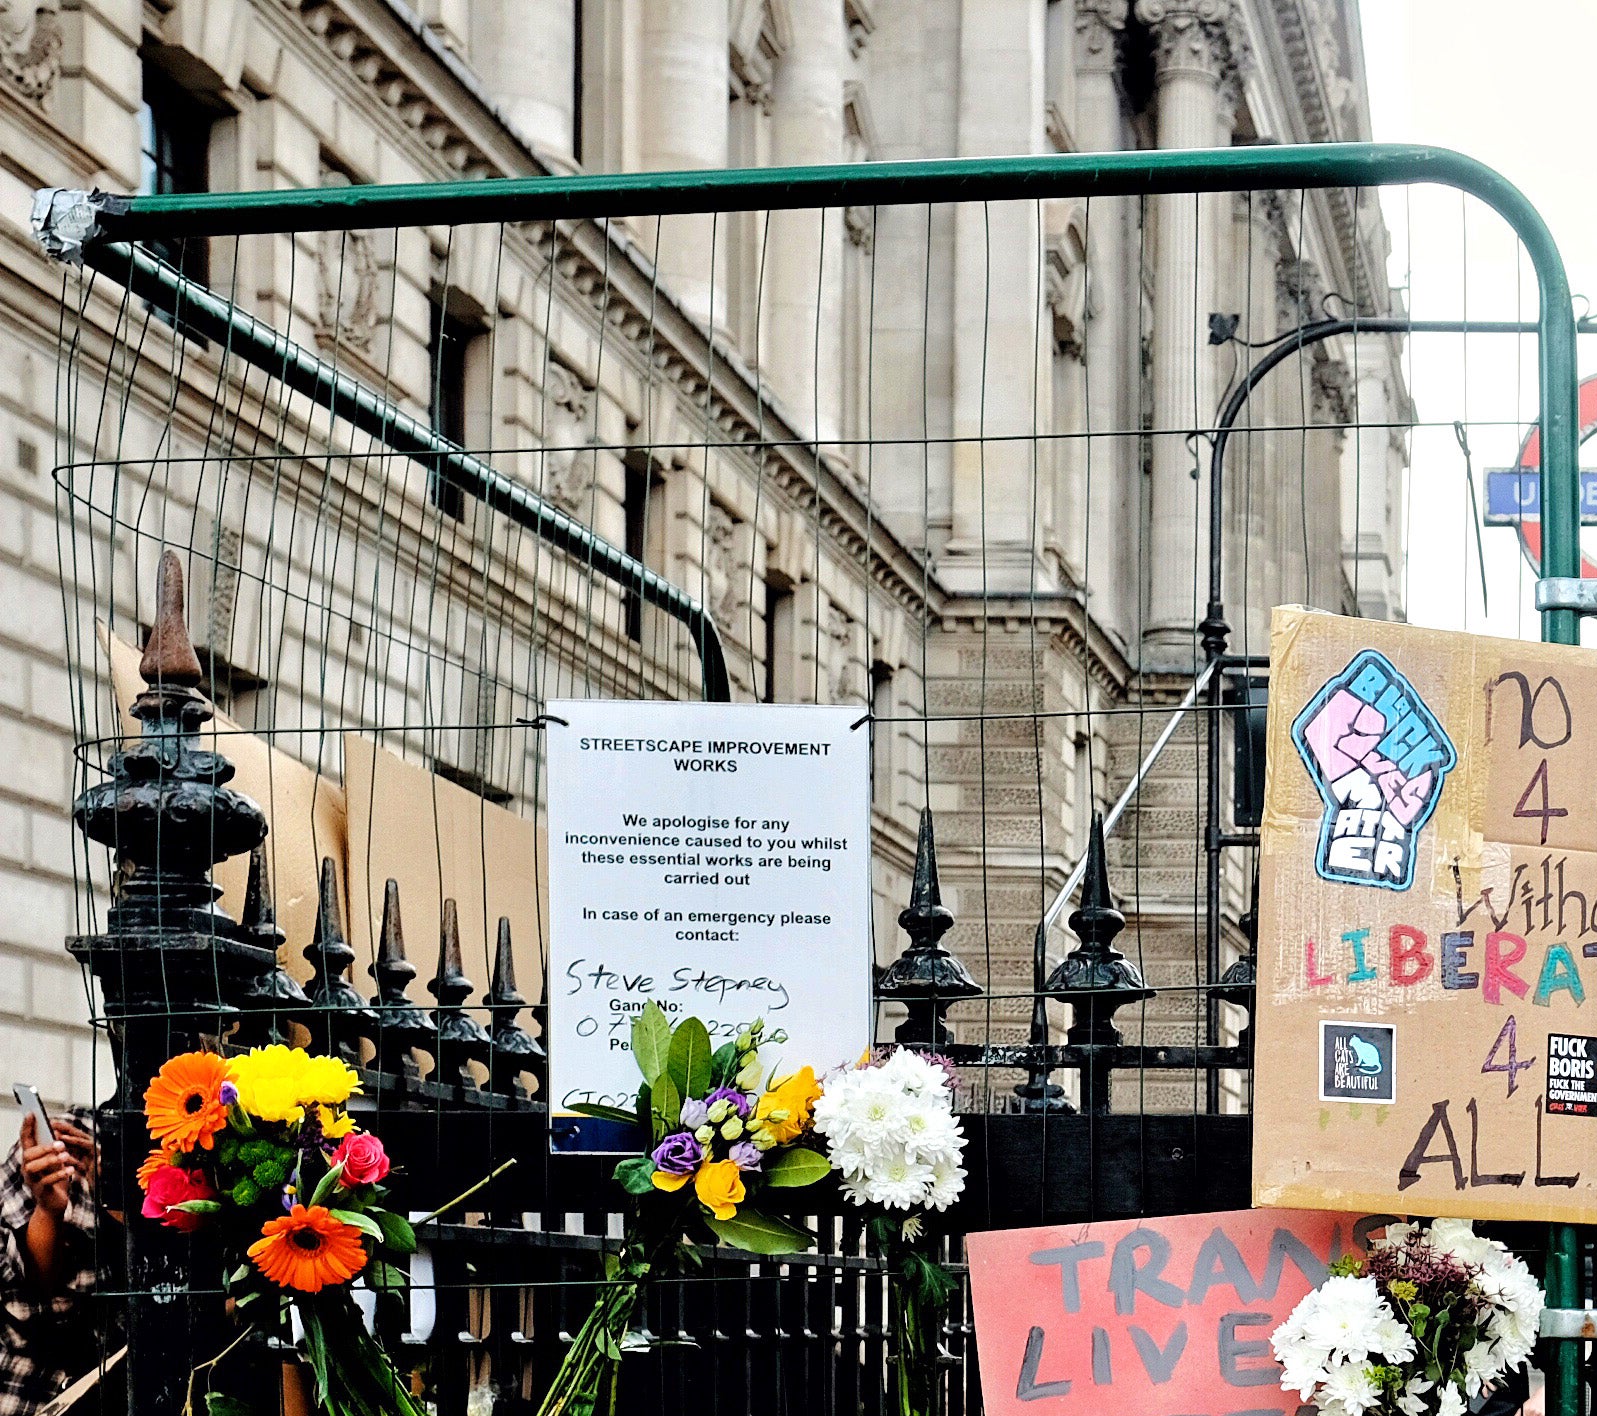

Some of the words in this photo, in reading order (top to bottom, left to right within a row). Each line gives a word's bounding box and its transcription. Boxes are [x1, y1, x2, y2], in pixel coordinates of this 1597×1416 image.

[580, 738, 702, 753] STREETSCAPE
[708, 741, 831, 756] IMPROVEMENT
[674, 758, 737, 773] WORKS
[1513, 758, 1568, 845] 4
[623, 814, 647, 827] We
[652, 815, 729, 831] apologise
[735, 816, 757, 829] for
[762, 818, 790, 832] any
[565, 833, 680, 847] inconvenience
[685, 835, 742, 849] caused
[747, 836, 762, 849] to
[767, 839, 796, 851] you
[801, 837, 848, 851] whilst
[582, 851, 624, 865] these
[629, 853, 700, 867] essential
[705, 854, 753, 867] works
[758, 857, 783, 868] are
[788, 856, 832, 871] being
[664, 872, 719, 885] carried
[724, 874, 750, 886] out
[583, 907, 597, 920] In
[602, 911, 639, 922] case
[644, 908, 660, 922] of
[664, 911, 683, 922] an
[688, 911, 775, 926] emergency
[780, 912, 831, 926] please
[675, 929, 739, 942] contact:
[566, 959, 655, 996] Steve
[657, 1000, 683, 1012] No:
[1334, 1036, 1347, 1050] ALL
[1550, 1036, 1588, 1058] FUCK
[1334, 1050, 1354, 1063] CATS
[1480, 1014, 1536, 1099] 4
[1334, 1063, 1350, 1076] ARE
[1549, 1057, 1595, 1079] BORIS
[1334, 1074, 1378, 1090] BEAUTIFUL
[1549, 1078, 1569, 1089] FUCK
[1571, 1080, 1586, 1091] THE
[1397, 1092, 1580, 1190] ALL
[1015, 1311, 1285, 1401] LIVE
